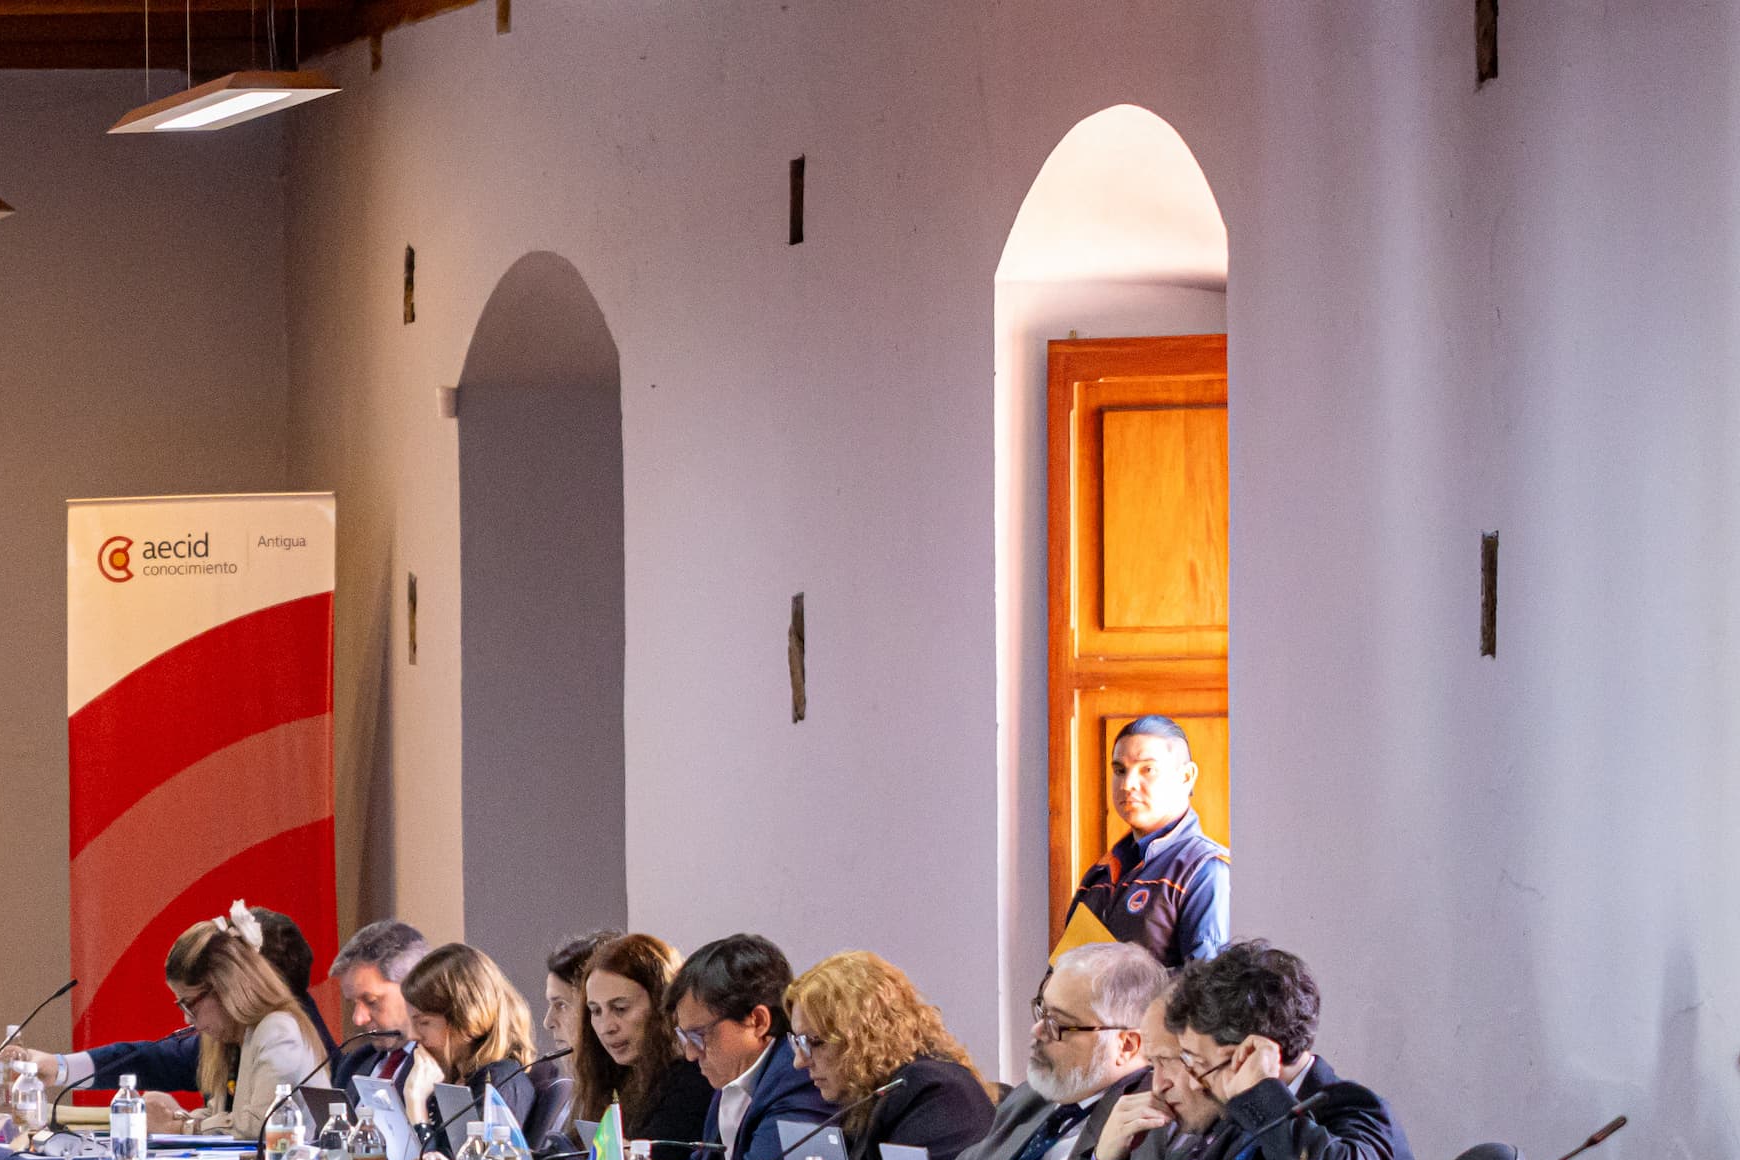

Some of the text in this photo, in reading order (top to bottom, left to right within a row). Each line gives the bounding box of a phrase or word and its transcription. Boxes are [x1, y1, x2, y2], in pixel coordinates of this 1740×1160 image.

[143, 532, 208, 559] aecid
[258, 536, 305, 549] Antigua
[143, 563, 237, 575] conocimiento
